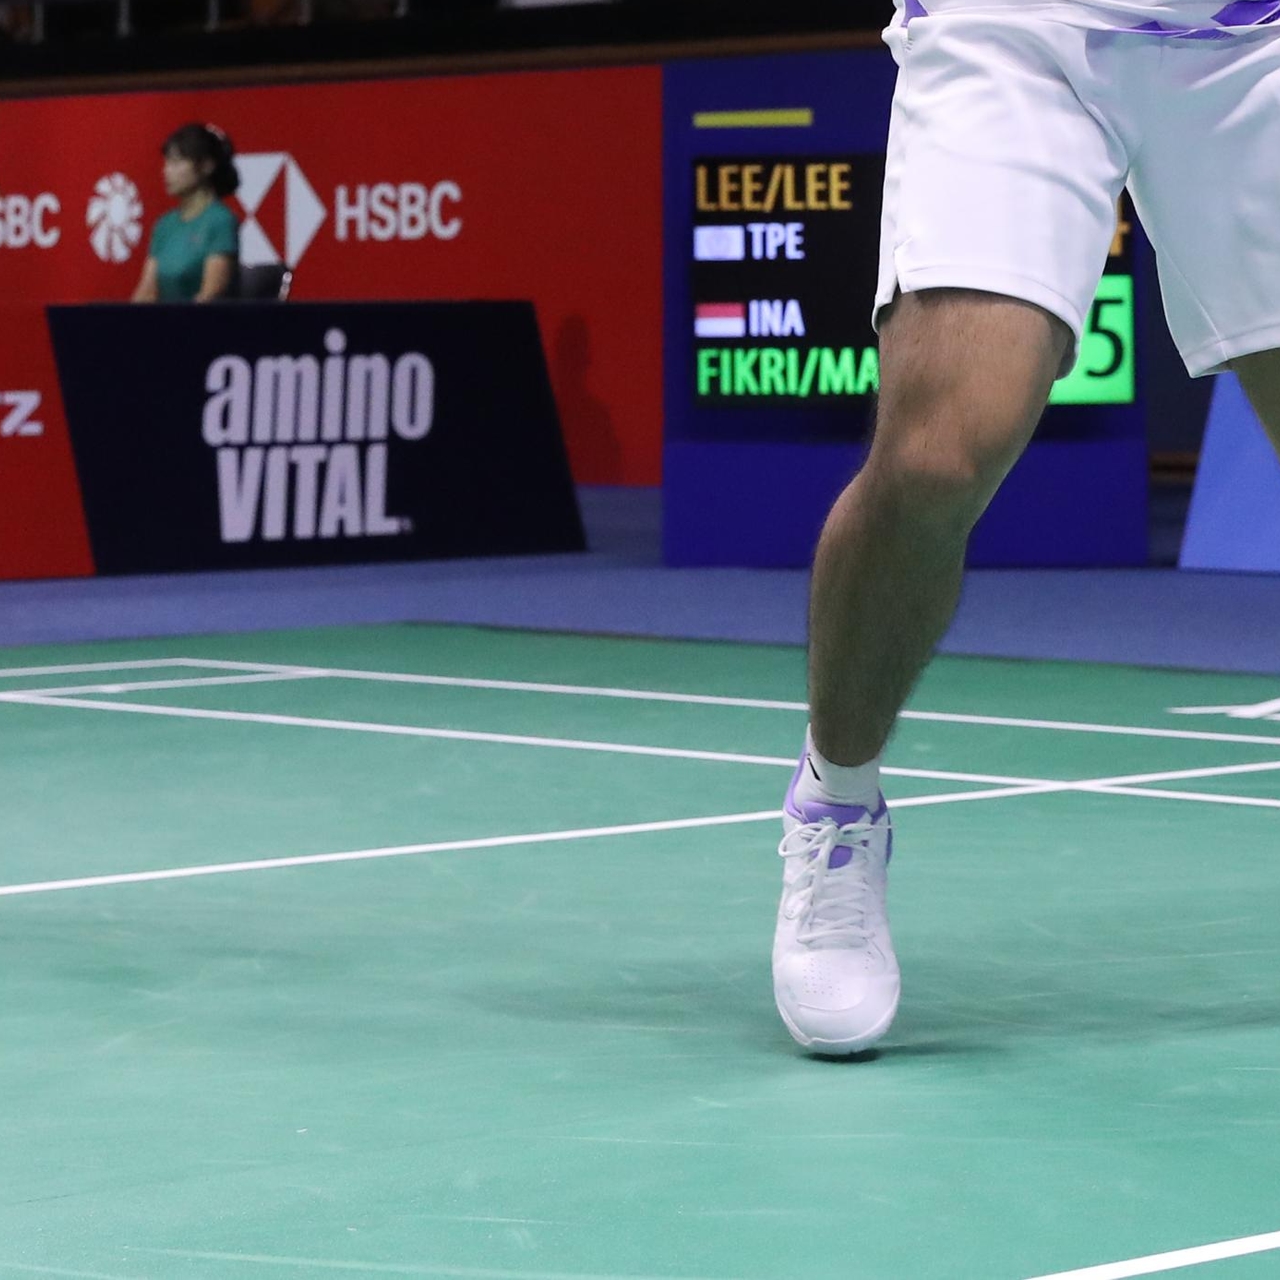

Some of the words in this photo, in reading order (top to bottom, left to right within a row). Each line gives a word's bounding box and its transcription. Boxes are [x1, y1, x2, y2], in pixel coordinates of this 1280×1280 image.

[334, 181, 462, 241] HSBC
[695, 163, 853, 213] LEE/LEE
[747, 222, 805, 260] TPE
[748, 299, 805, 338] INA
[202, 327, 435, 447] amino
[216, 441, 404, 544] VITAL
